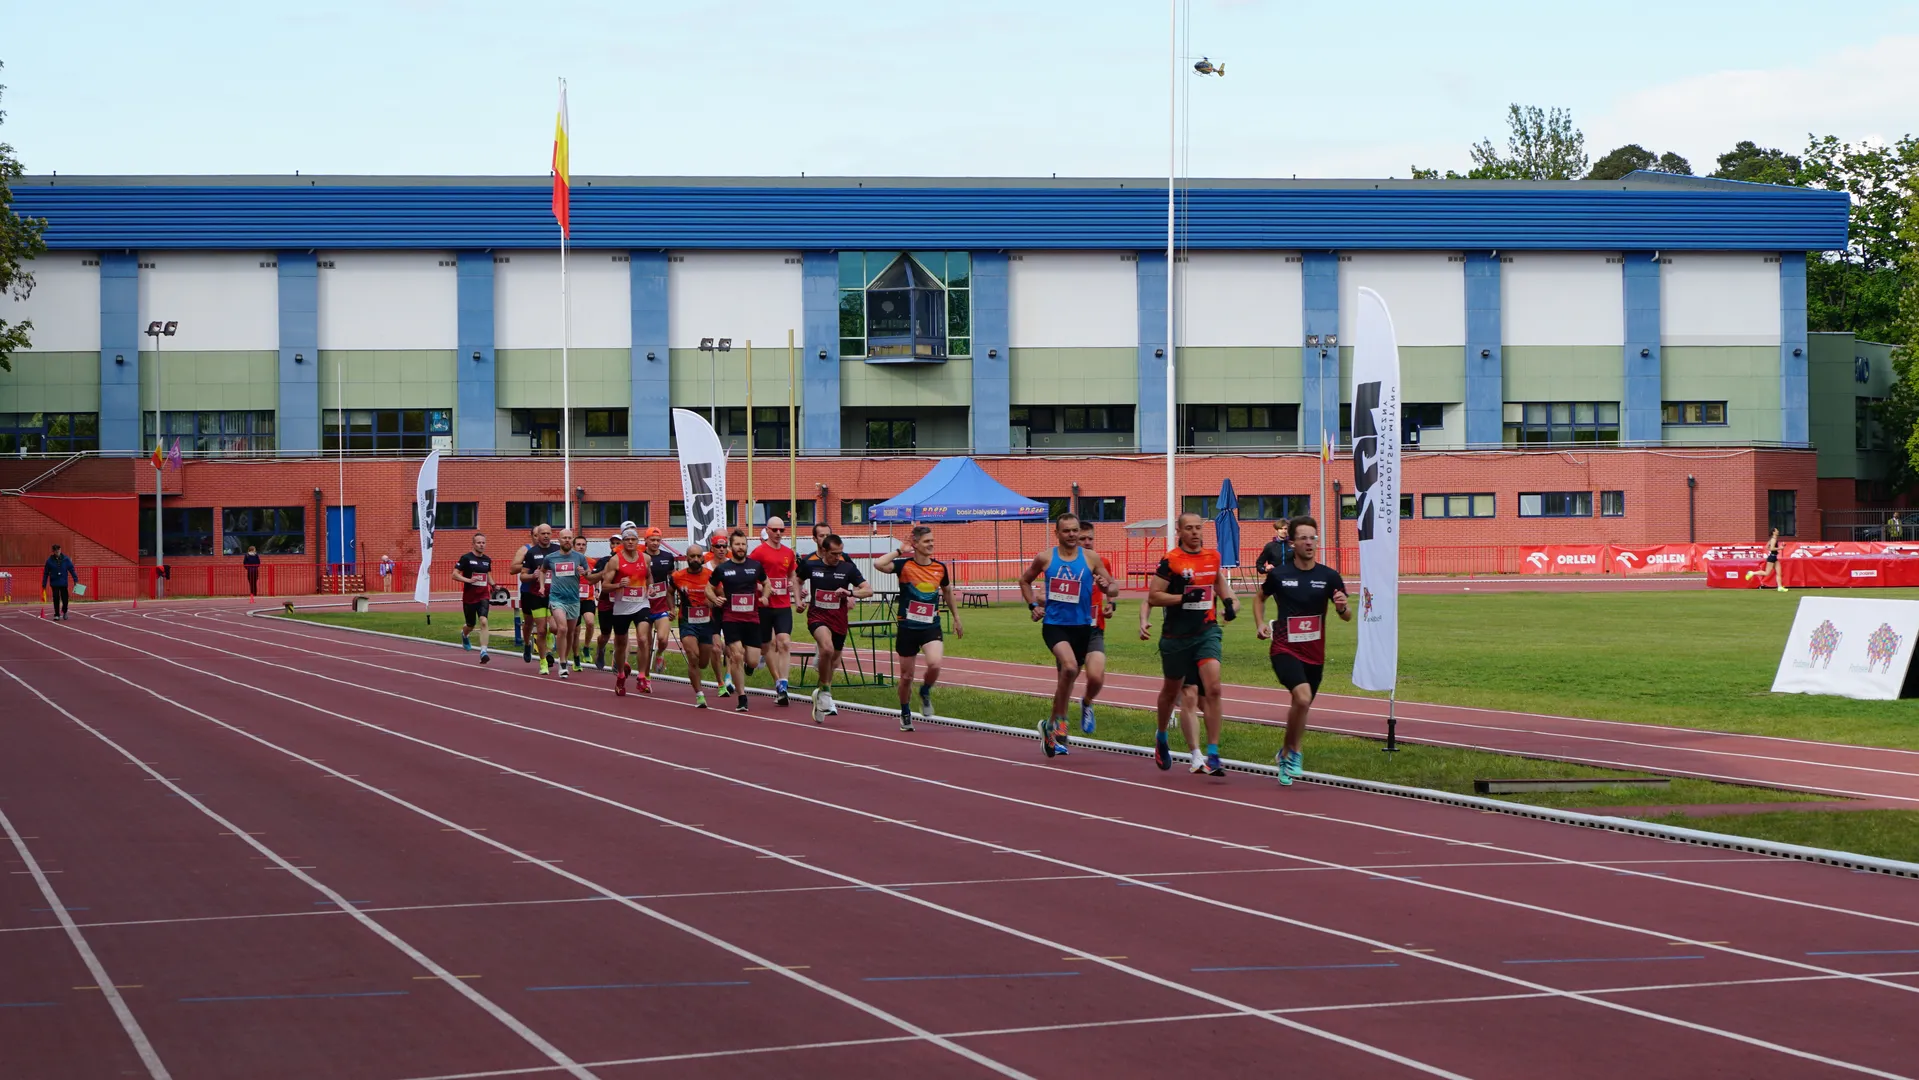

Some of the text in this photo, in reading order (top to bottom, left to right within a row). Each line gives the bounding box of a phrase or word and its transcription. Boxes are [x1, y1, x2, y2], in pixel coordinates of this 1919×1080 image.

[1557, 554, 1596, 565] ORLEN
[1646, 553, 1685, 565] ORLEN
[1058, 583, 1070, 593] 41
[739, 596, 748, 605] 40
[822, 594, 833, 602] 44
[695, 609, 704, 617] 43
[1298, 620, 1312, 631] 42
